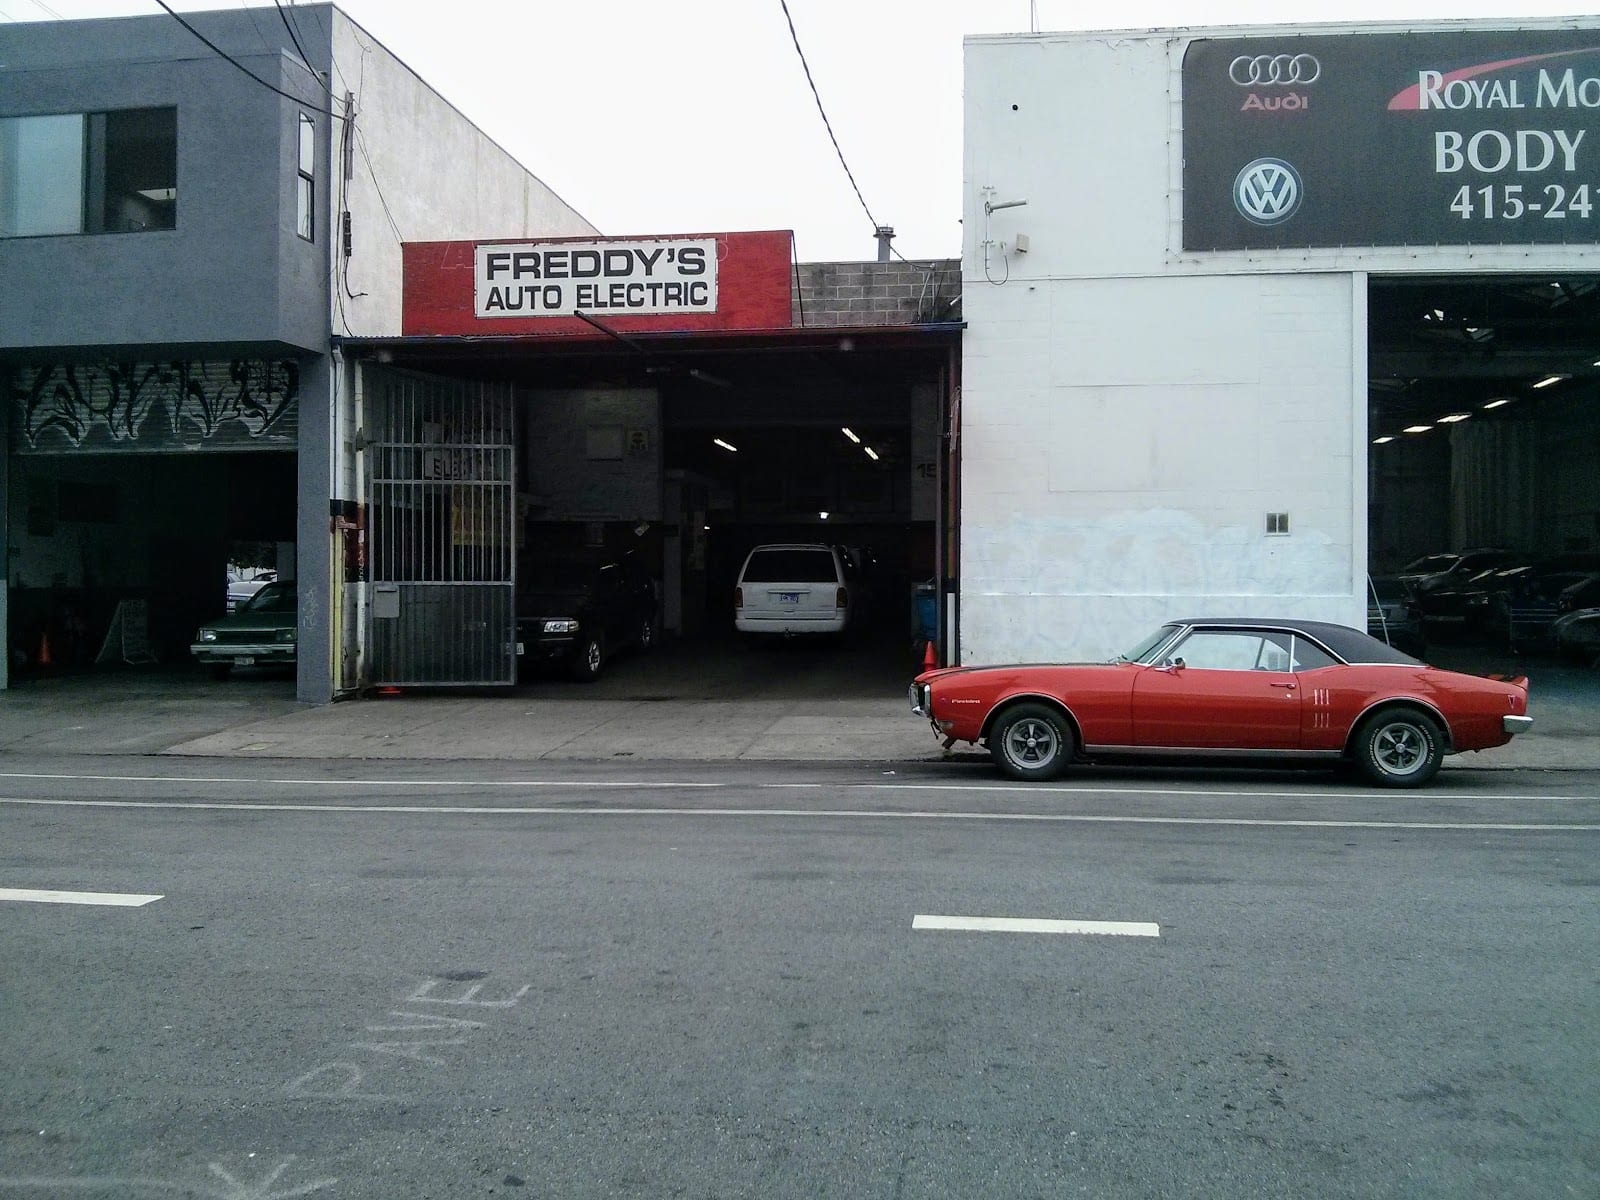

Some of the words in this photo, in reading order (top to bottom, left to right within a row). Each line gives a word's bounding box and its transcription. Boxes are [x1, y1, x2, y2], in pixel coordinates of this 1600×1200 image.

[1240, 92, 1308, 111] Audi
[1434, 129, 1586, 173] BODY
[1450, 184, 1600, 219] 415-24
[486, 247, 706, 281] FREDDY'S
[485, 284, 562, 311] AUTO
[576, 281, 708, 309] ELECTRIC
